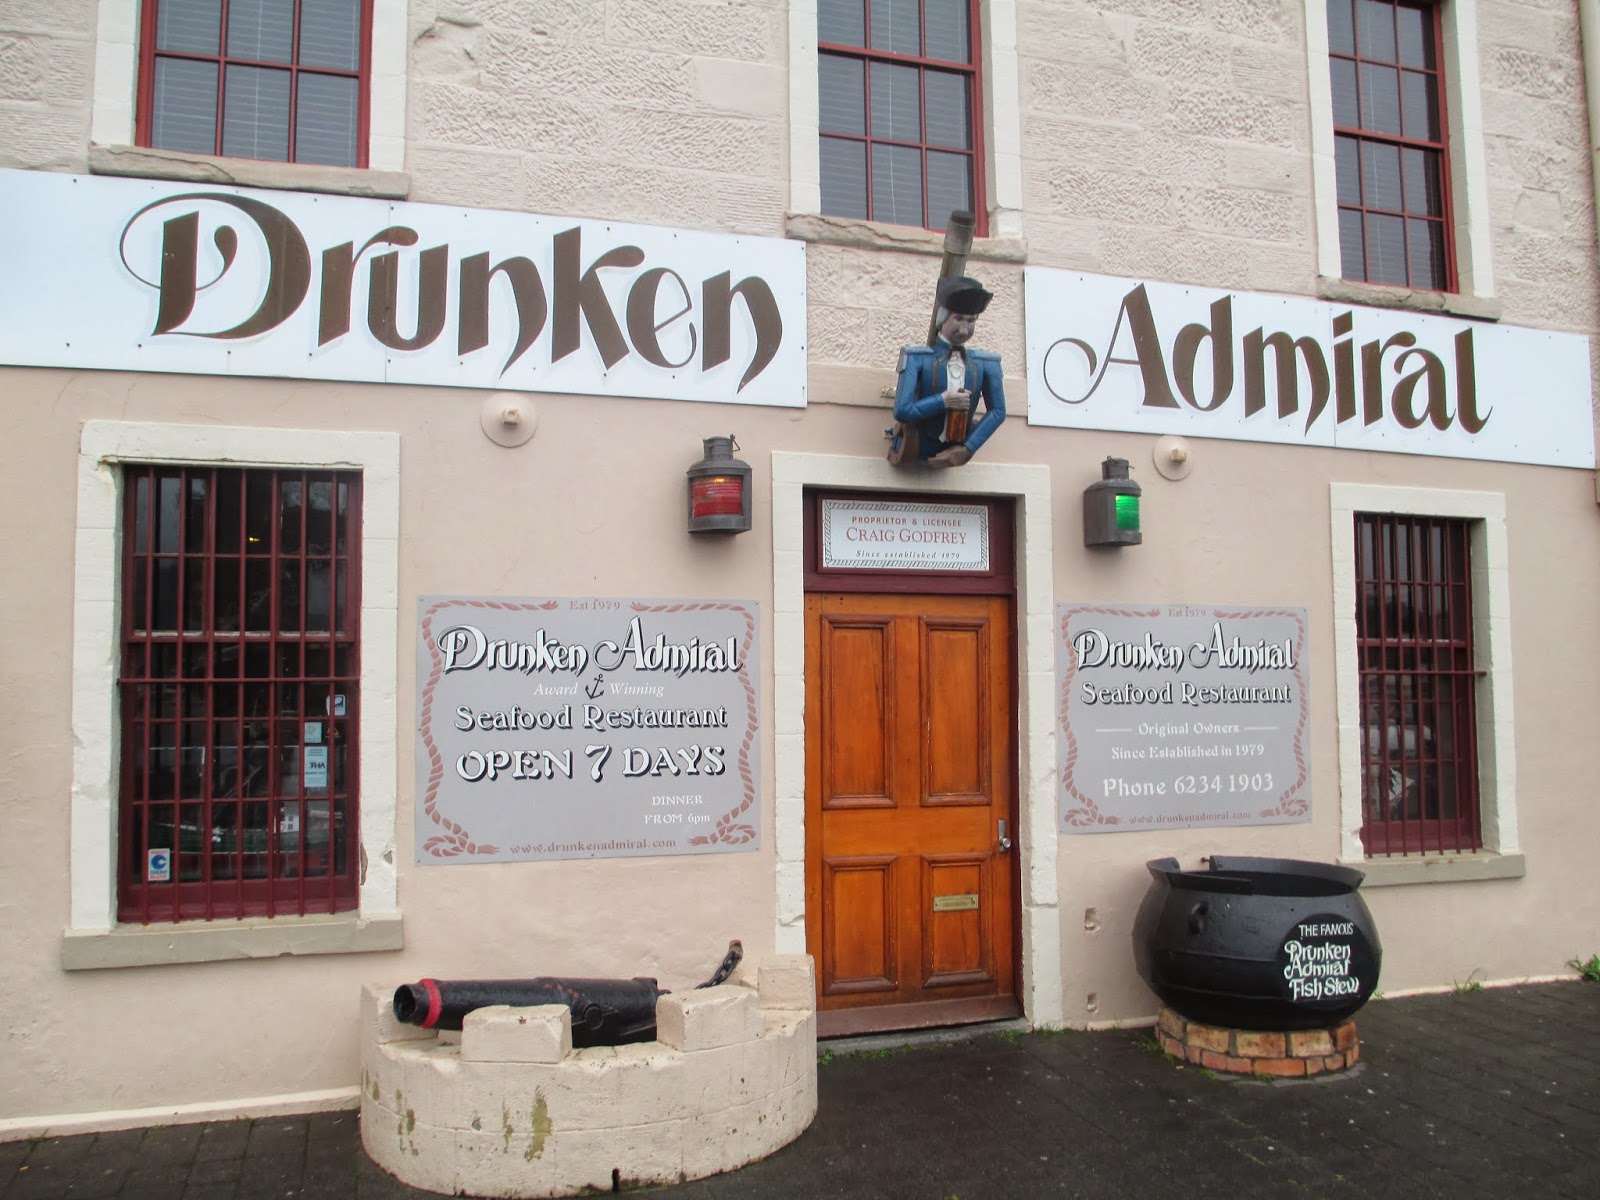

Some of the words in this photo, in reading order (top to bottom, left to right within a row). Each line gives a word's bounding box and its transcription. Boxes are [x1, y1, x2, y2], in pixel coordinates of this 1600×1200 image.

[120, 193, 783, 394] Drunken
[1043, 282, 1493, 437] Admiral
[851, 516, 907, 525] PROPRIETOR
[923, 519, 962, 527] LICENSEE
[846, 527, 895, 542] CRAIG
[899, 528, 967, 545] GODFREY
[856, 550, 880, 558] Since
[885, 550, 937, 559] established
[941, 551, 960, 560] 1979
[593, 600, 620, 610] 1979
[437, 624, 589, 677] Drunken
[592, 616, 744, 679] Admiral
[1072, 627, 1184, 673] Drunken
[1186, 620, 1298, 674] Admiral
[534, 682, 578, 697] Award
[609, 682, 664, 699] Winning
[1080, 682, 1173, 705] Seafood
[1181, 682, 1292, 706] Restaurant
[454, 703, 573, 732] Seafood
[581, 703, 728, 732] Restaurant
[1138, 722, 1189, 737] Original
[1193, 722, 1240, 735] Owners
[1111, 747, 1145, 760] Since
[1149, 745, 1219, 759] Established
[1221, 746, 1232, 757] in
[1235, 744, 1264, 756] 1979
[456, 749, 574, 783] OPEN
[584, 744, 612, 782] 7
[622, 744, 726, 777] DAYS
[1103, 778, 1167, 797] Phone
[1174, 775, 1222, 794] 6234
[1229, 773, 1274, 792] 1903
[652, 795, 703, 807] DINNER
[644, 813, 683, 825] FROM
[687, 813, 711, 826] 6pm
[509, 838, 677, 855] www.drunkenadmiral.com
[1299, 924, 1318, 937] THE
[1320, 922, 1354, 936] FAMOUS
[1284, 940, 1351, 963] Drunken
[1283, 953, 1352, 979] Admiral
[1288, 977, 1322, 1000] Fish
[1324, 976, 1359, 996] Stew
